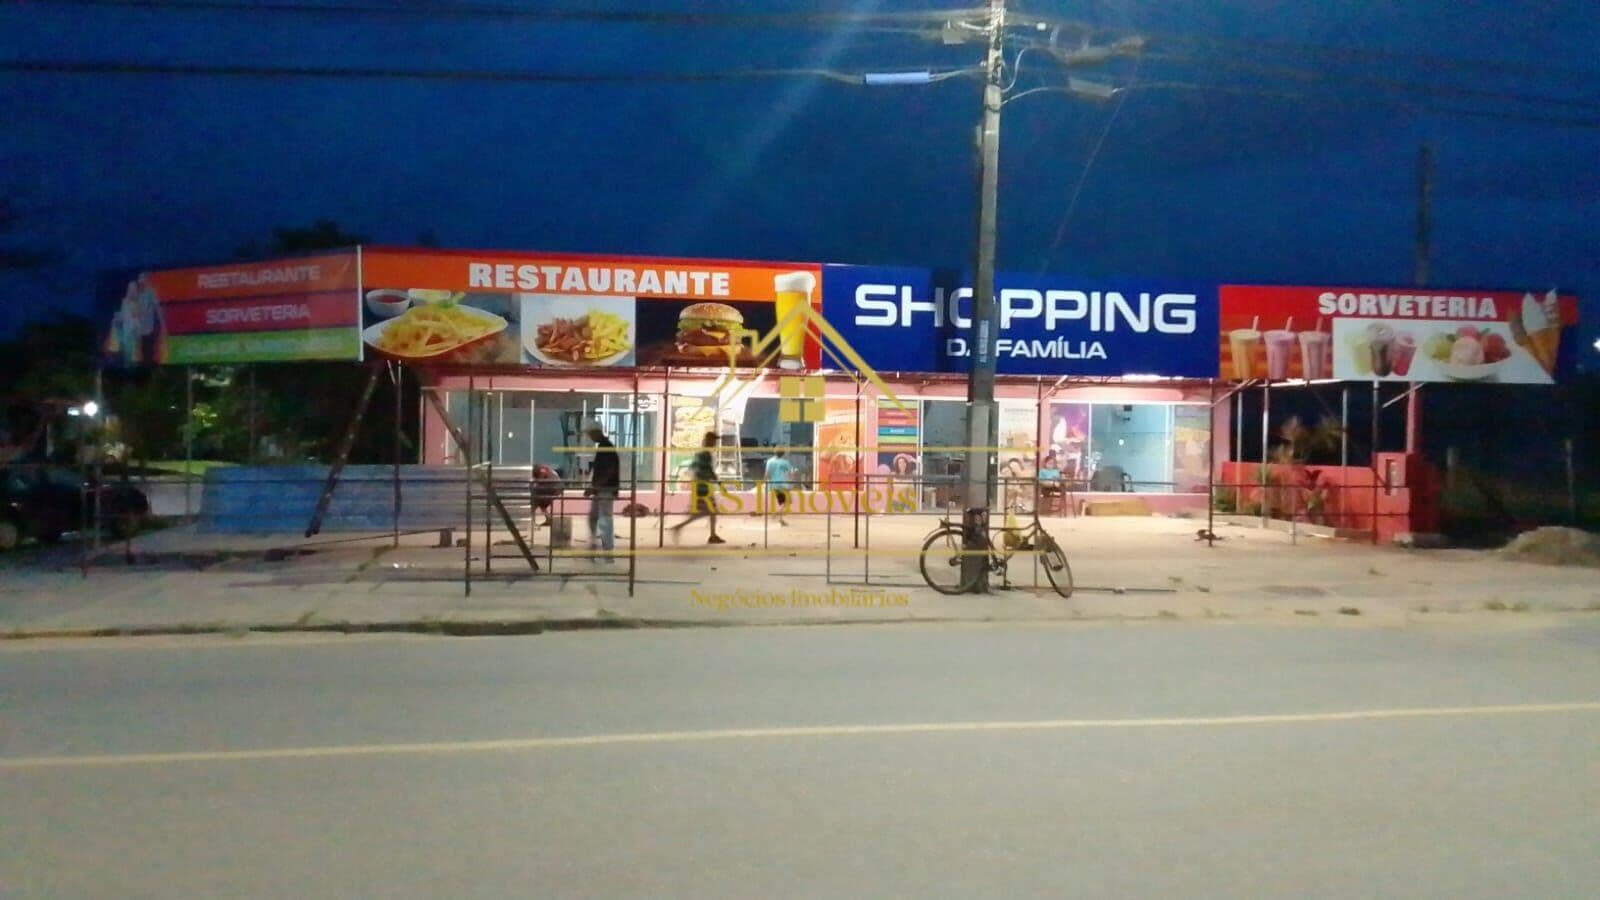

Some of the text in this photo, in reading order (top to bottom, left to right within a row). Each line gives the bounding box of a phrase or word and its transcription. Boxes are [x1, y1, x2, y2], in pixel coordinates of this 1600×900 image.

[197, 264, 321, 289] RESTAURANTE
[469, 263, 729, 296] RESTAURANTE
[205, 304, 311, 325] SORVETERIA
[1318, 293, 1497, 318] SORVETERIA
[946, 338, 971, 357] D
[995, 336, 1107, 360] FAMÍLIA
